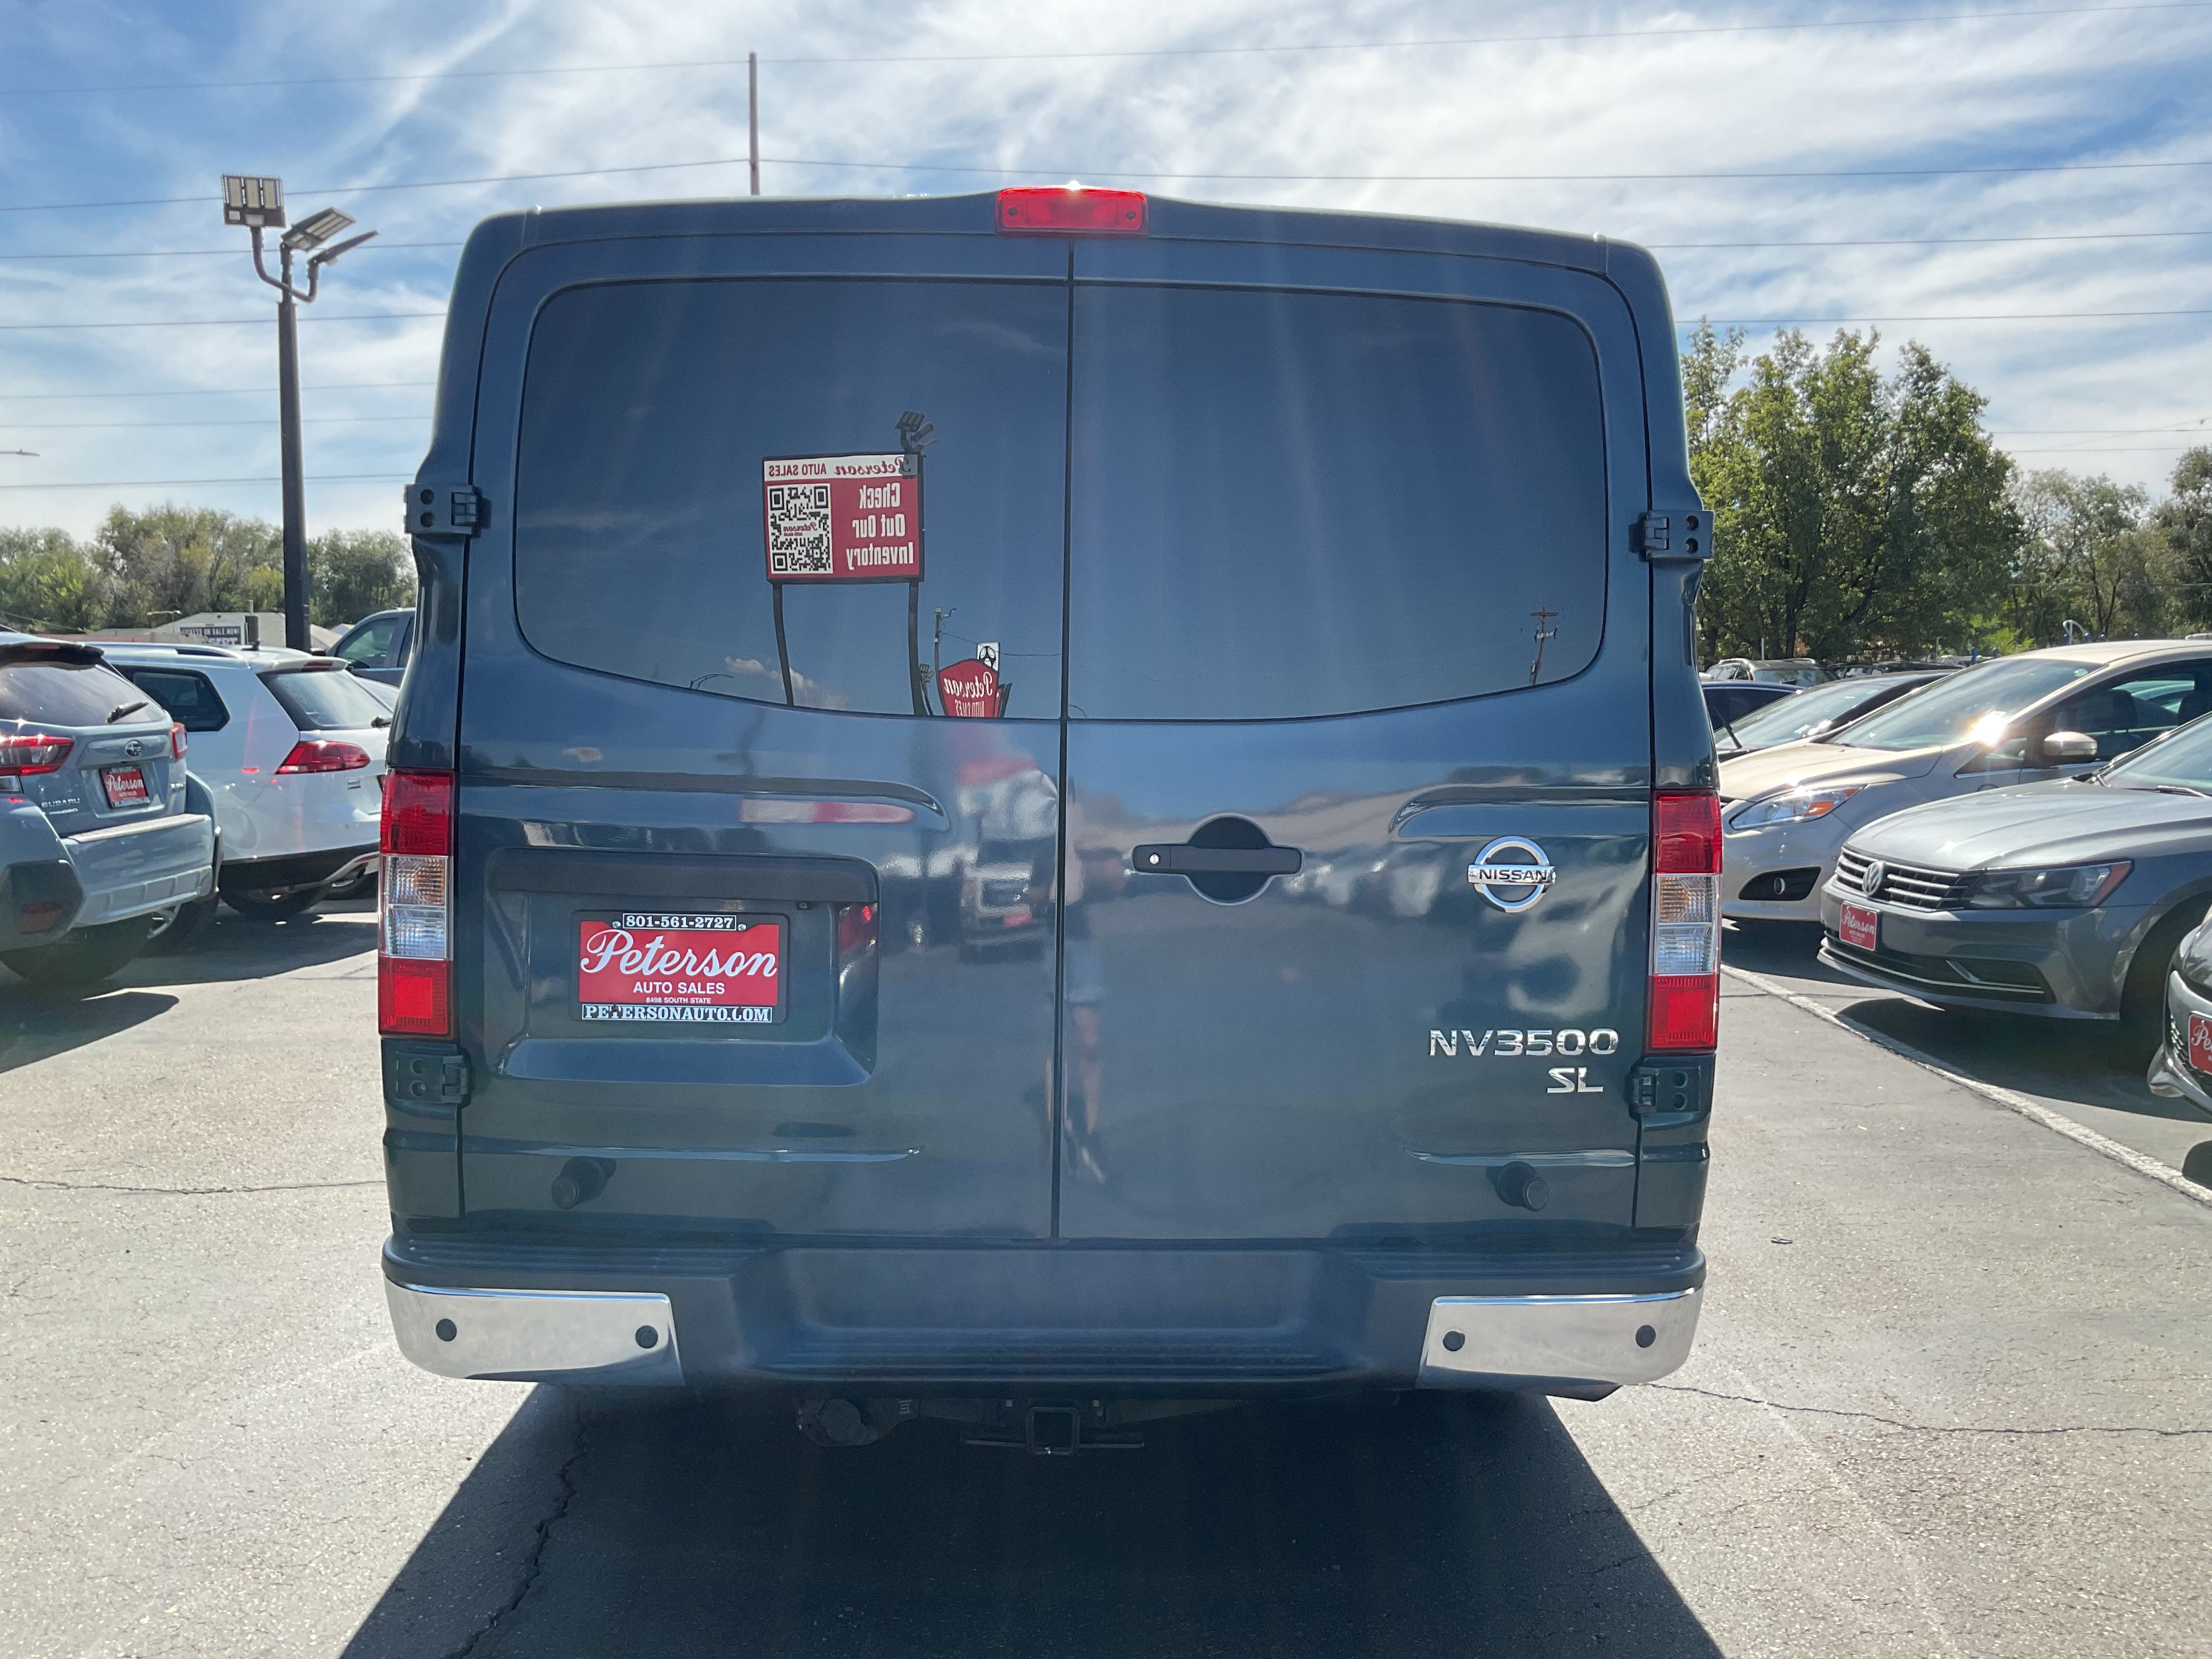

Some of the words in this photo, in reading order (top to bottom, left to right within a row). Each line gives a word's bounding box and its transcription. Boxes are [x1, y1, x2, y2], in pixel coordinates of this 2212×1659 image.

[105, 775, 144, 792] Peterson
[41, 798, 80, 808] SUBARU
[1479, 868, 1547, 880] NISSAN
[625, 915, 734, 928] 801-561-2727
[1842, 909, 1875, 935] Peterson
[580, 929, 777, 977] Peterson
[633, 981, 673, 994] AUTO
[678, 981, 725, 995] SALES
[1429, 1029, 1619, 1057] NV3500
[2191, 1025, 2212, 1052] Pe
[1547, 1067, 1604, 1093] SL
